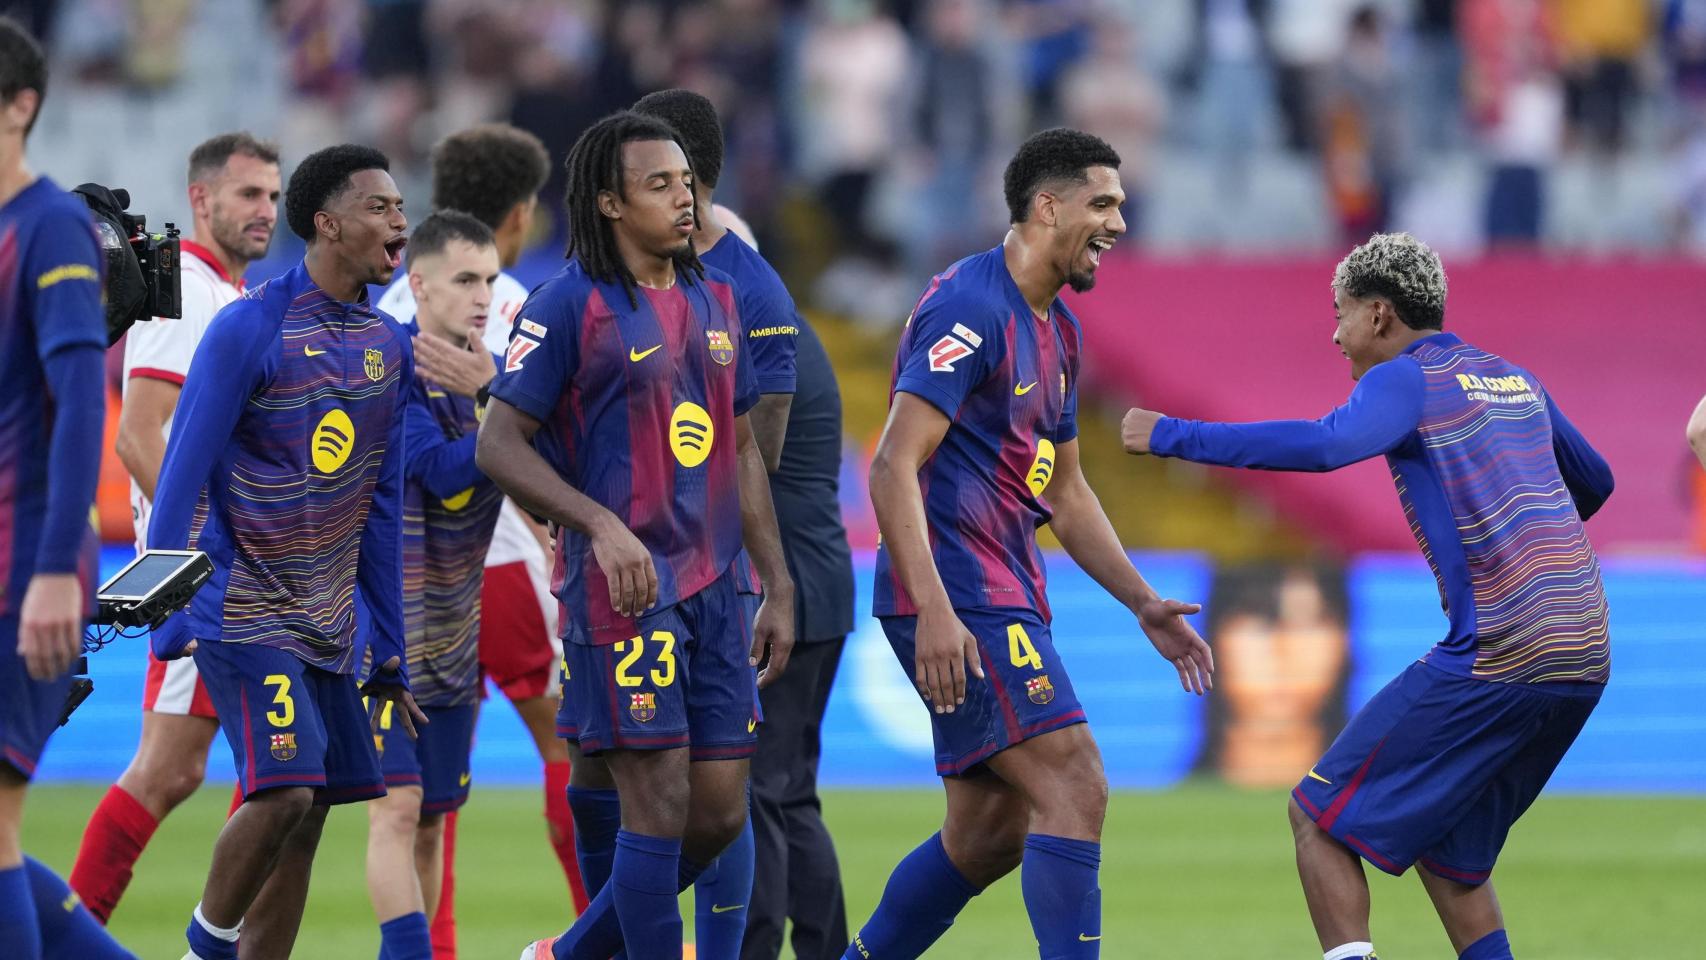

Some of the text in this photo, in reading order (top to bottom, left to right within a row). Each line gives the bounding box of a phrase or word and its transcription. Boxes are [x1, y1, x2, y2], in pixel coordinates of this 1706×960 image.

[750, 326, 795, 338] AMBILIGHT
[614, 631, 676, 687] 23
[1007, 623, 1043, 670] 4
[264, 674, 295, 728] 3
